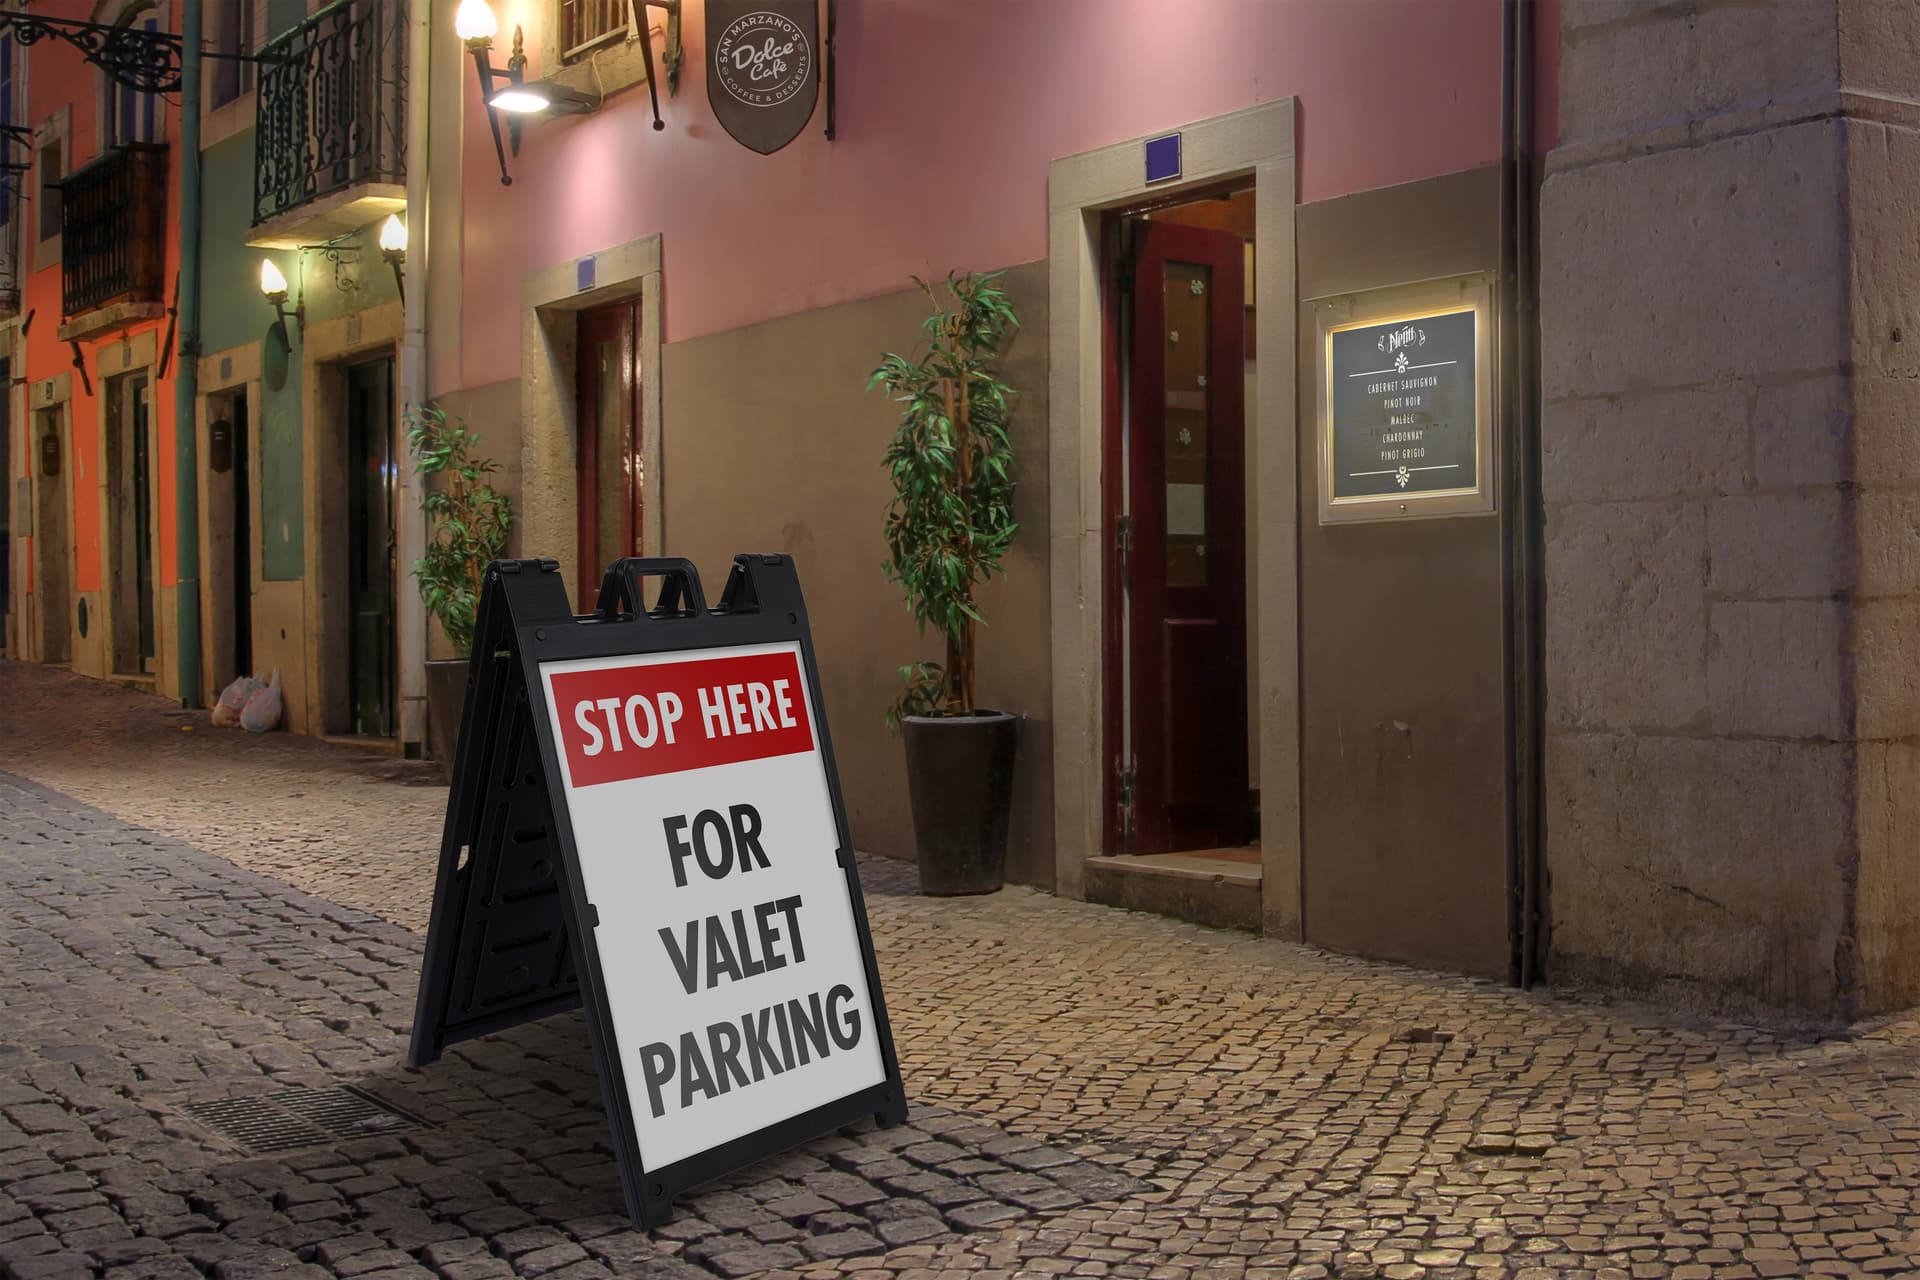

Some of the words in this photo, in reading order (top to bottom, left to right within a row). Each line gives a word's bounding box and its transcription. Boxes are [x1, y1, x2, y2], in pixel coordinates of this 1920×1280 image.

[720, 38, 732, 63] SAN
[730, 15, 800, 41] MARZANO'S
[731, 37, 794, 70] Dolce
[727, 77, 761, 102] COFFEE
[776, 56, 806, 99] DESSERTS
[1367, 380, 1398, 394] CABERNET
[1401, 376, 1438, 390] SAUVIGNON
[1384, 398, 1402, 409] PINOT
[1405, 395, 1421, 407] NOIR
[1382, 430, 1424, 444] CHARDONNAY
[1390, 413, 1415, 425] MALBEC
[1381, 449, 1399, 461] PINOT
[1402, 447, 1425, 460] GRIGIO
[574, 692, 684, 756] STOP
[697, 679, 797, 739] HERE
[662, 803, 772, 888] FOR
[657, 894, 806, 995] VALET
[638, 983, 862, 1119] PARKING
